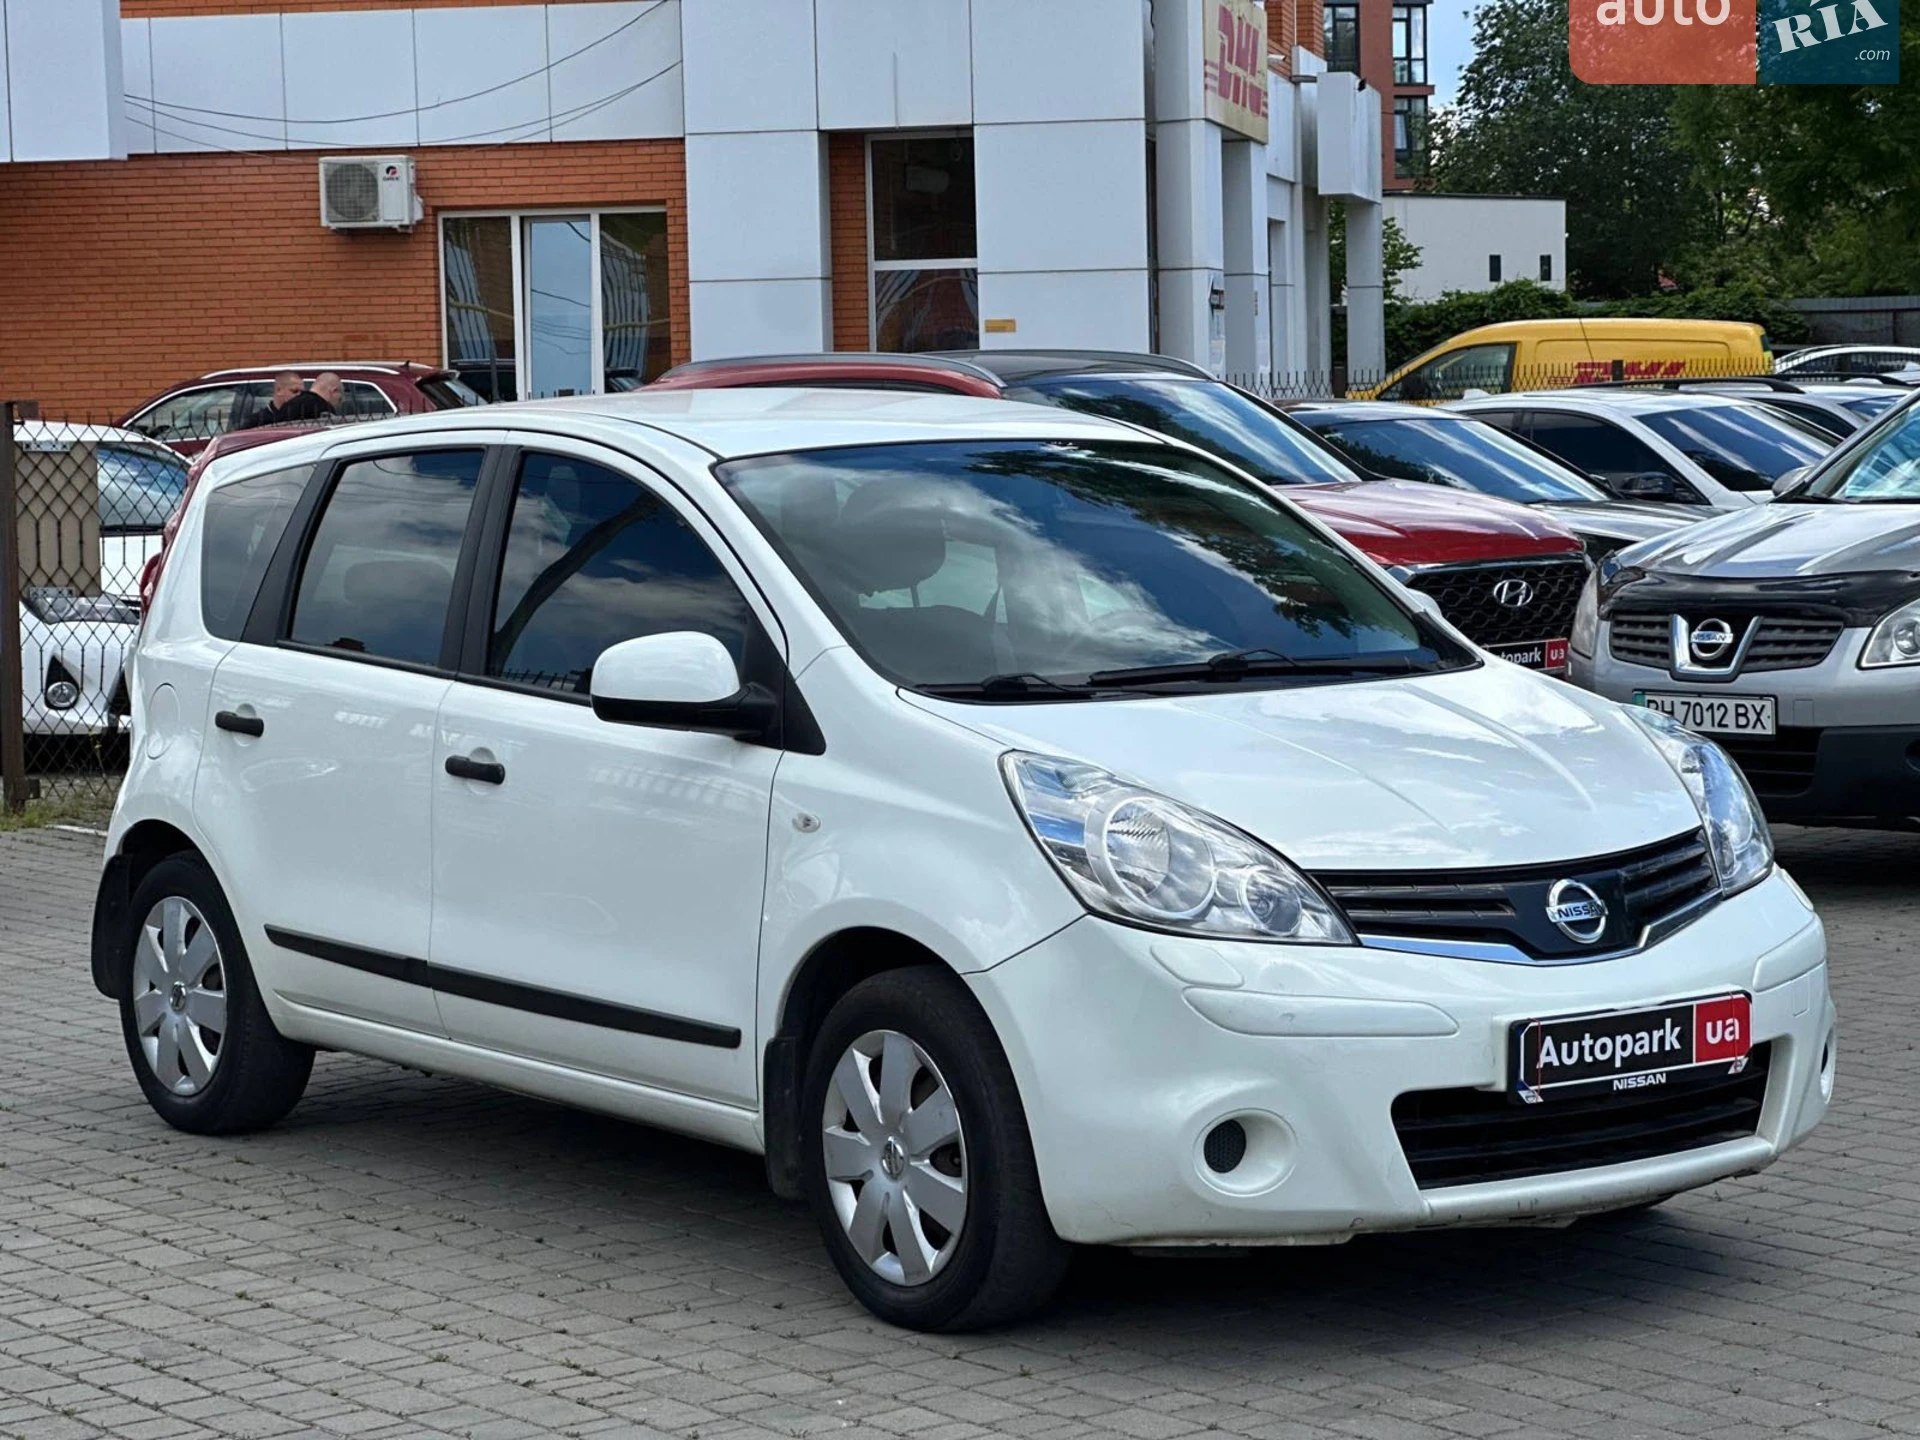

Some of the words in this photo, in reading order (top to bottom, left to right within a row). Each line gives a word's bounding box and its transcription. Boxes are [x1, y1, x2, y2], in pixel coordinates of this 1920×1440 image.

[1215, 4, 1262, 118] DHL
[1499, 646, 1542, 664] topark
[1680, 700, 1729, 729] 7012
[1734, 702, 1767, 730] BX
[1536, 1018, 1683, 1069] Autopark
[1706, 1017, 1741, 1045] ua
[1612, 1072, 1668, 1092] NISSAN
